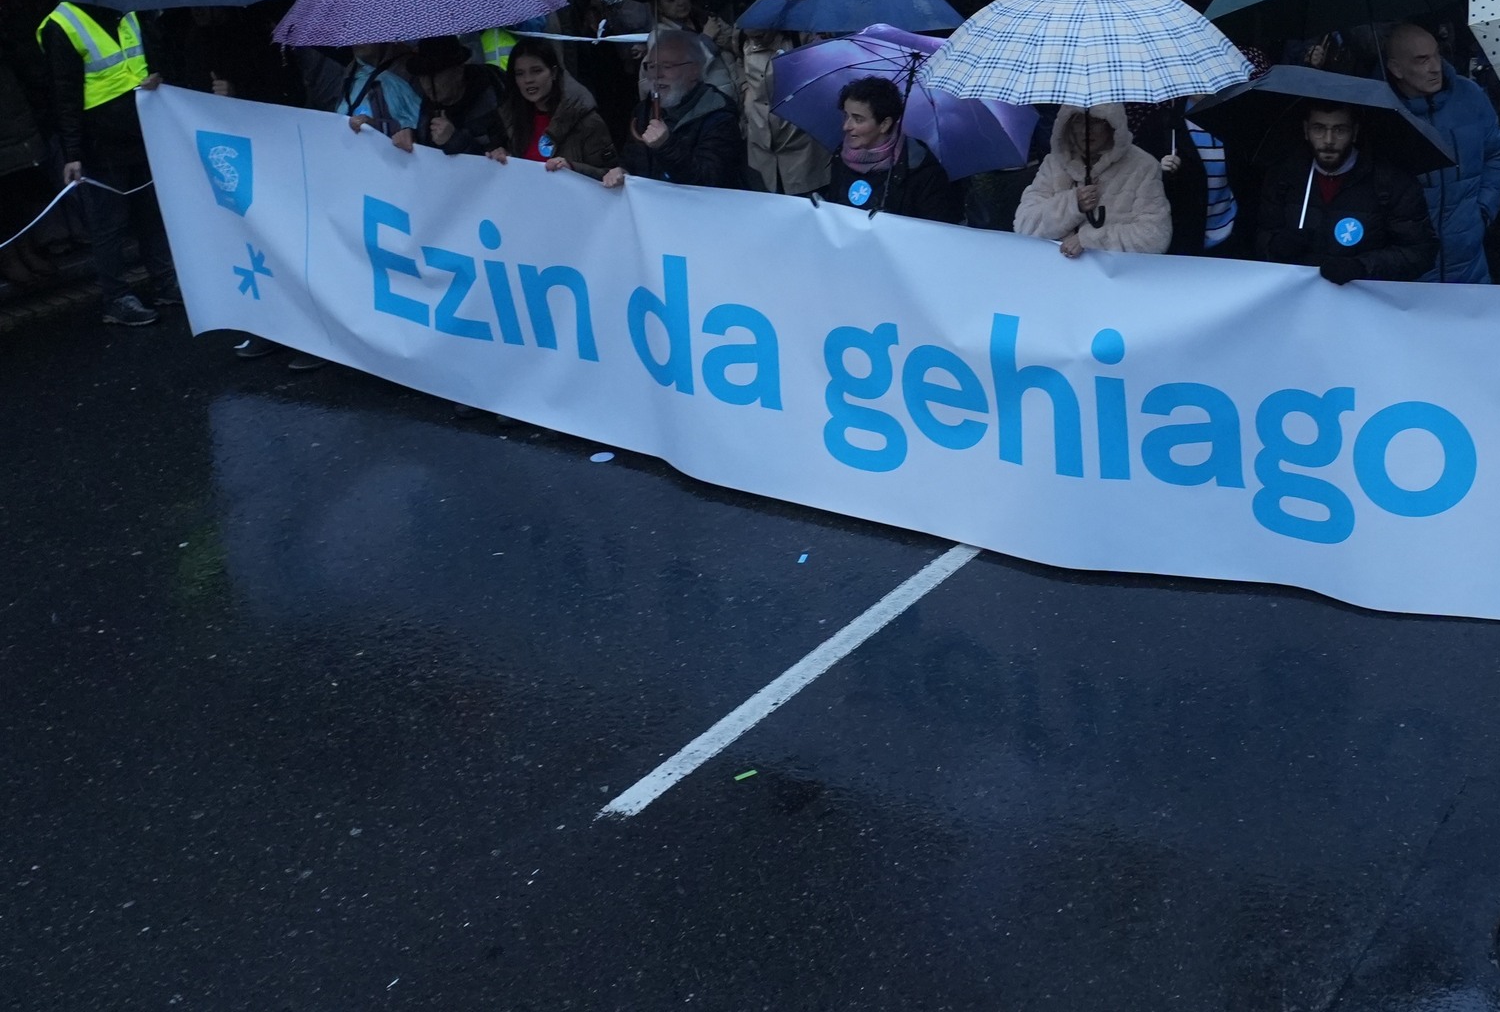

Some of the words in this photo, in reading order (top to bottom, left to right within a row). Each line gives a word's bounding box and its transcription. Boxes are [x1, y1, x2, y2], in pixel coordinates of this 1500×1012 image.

[363, 195, 600, 362] Ezin
[626, 254, 784, 411] da
[822, 313, 1478, 545] gehiago
